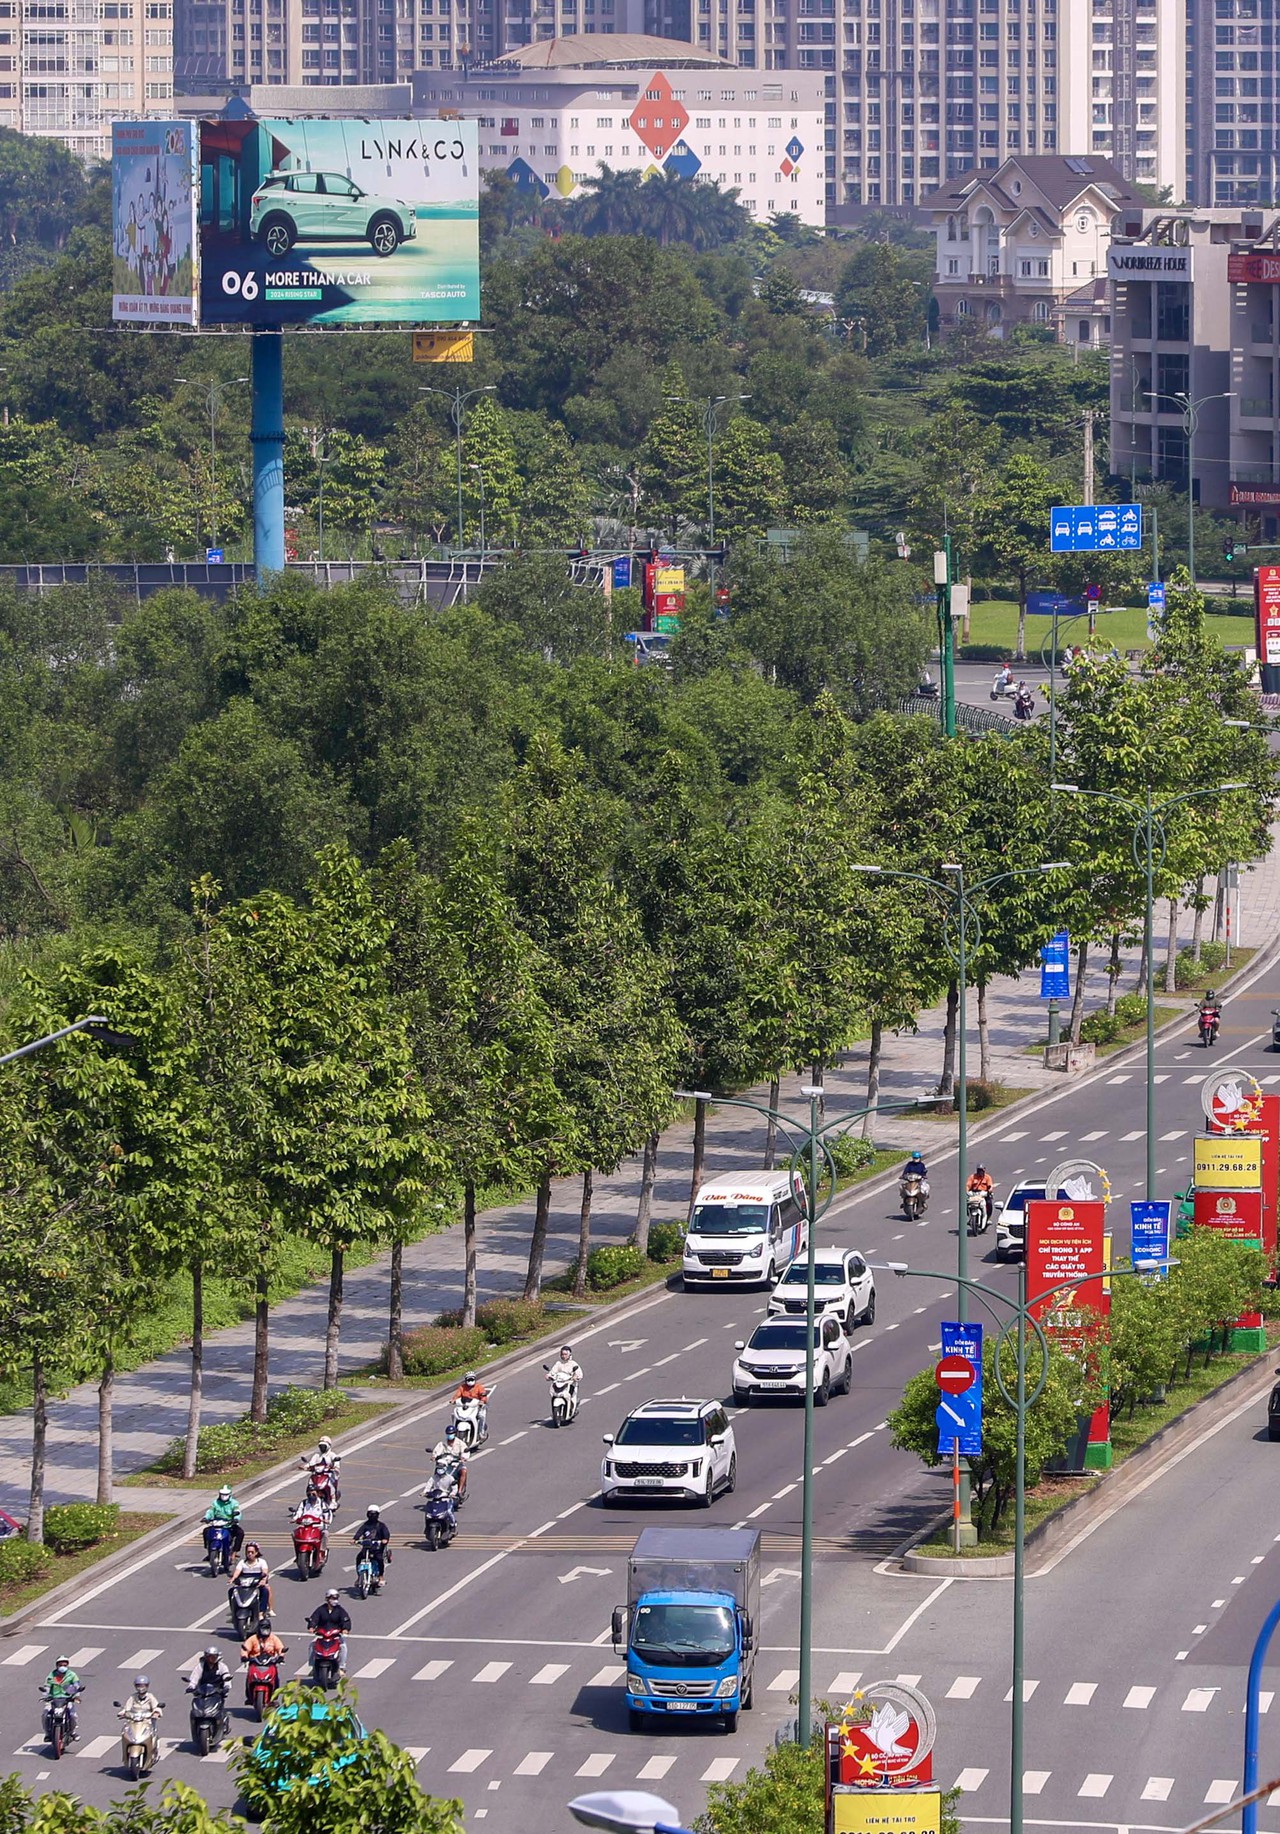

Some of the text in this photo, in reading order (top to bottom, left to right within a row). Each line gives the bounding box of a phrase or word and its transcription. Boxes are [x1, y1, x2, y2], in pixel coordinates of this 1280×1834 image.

[265, 272, 371, 286] MORE THAN A CAR
[222, 271, 258, 300] 06
[1153, 1221, 1161, 1230] TẾ
[965, 1345, 974, 1353] TẾ
